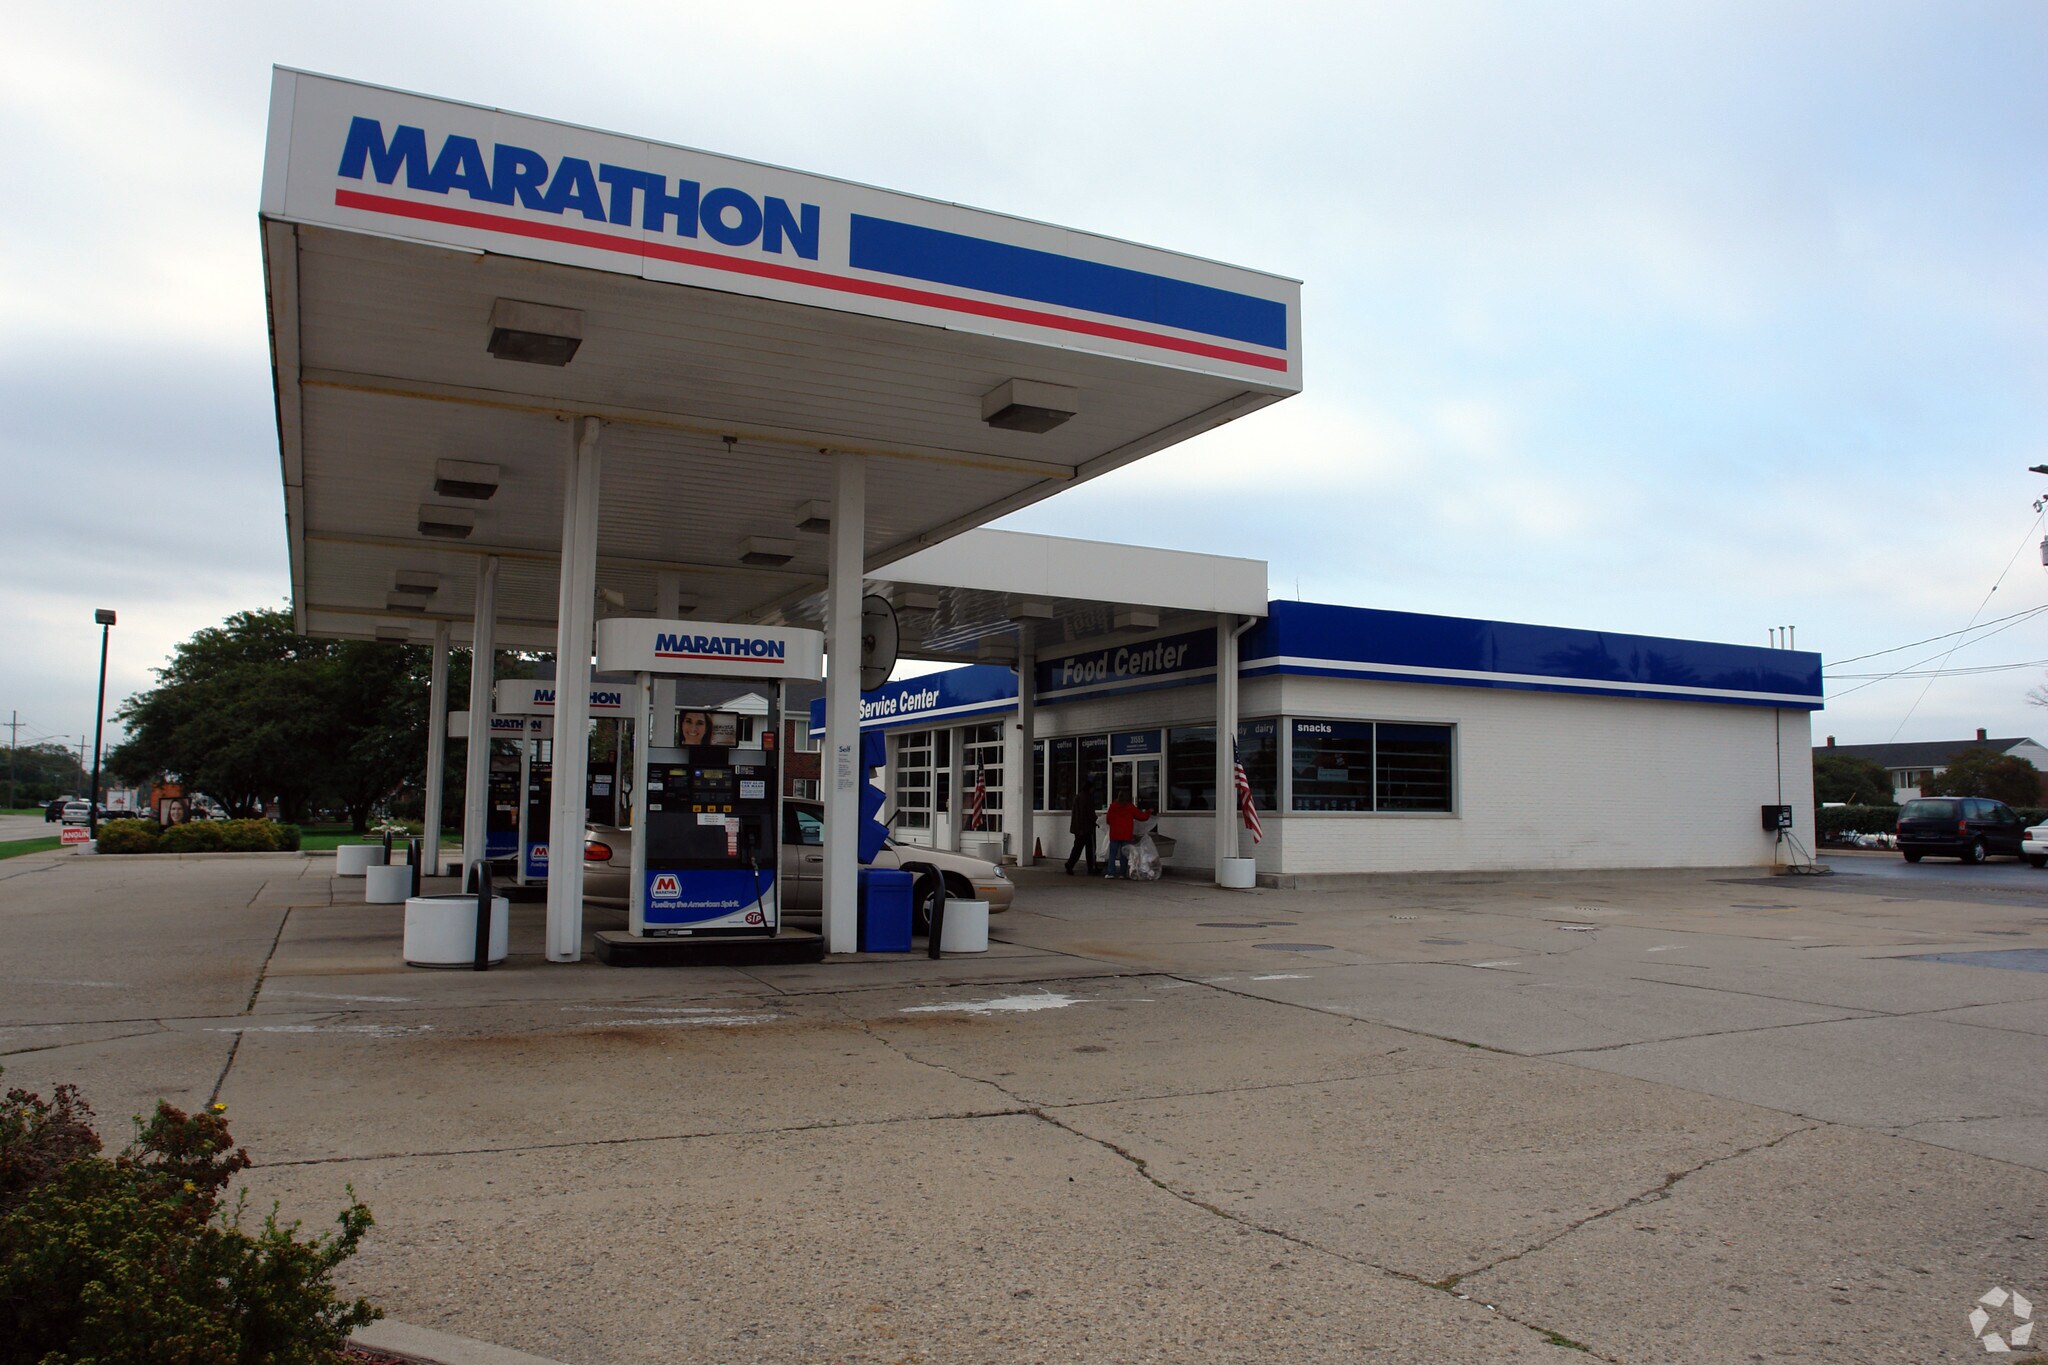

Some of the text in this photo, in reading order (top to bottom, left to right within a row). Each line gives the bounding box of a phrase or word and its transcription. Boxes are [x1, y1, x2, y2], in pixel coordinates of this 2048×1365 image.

[338, 116, 820, 260] MARATHON
[655, 634, 785, 658] MARATHON
[1062, 642, 1189, 686] Food Center
[534, 689, 621, 704] MAHON
[859, 688, 940, 719] Service Center
[1255, 724, 1274, 734] dairy
[1297, 723, 1332, 733] snacks
[1057, 741, 1072, 749] coffee
[1082, 738, 1107, 748] cigarettes
[657, 878, 676, 890] M
[651, 900, 676, 909] Fueling
[687, 900, 720, 908] American
[746, 912, 762, 923] STP
